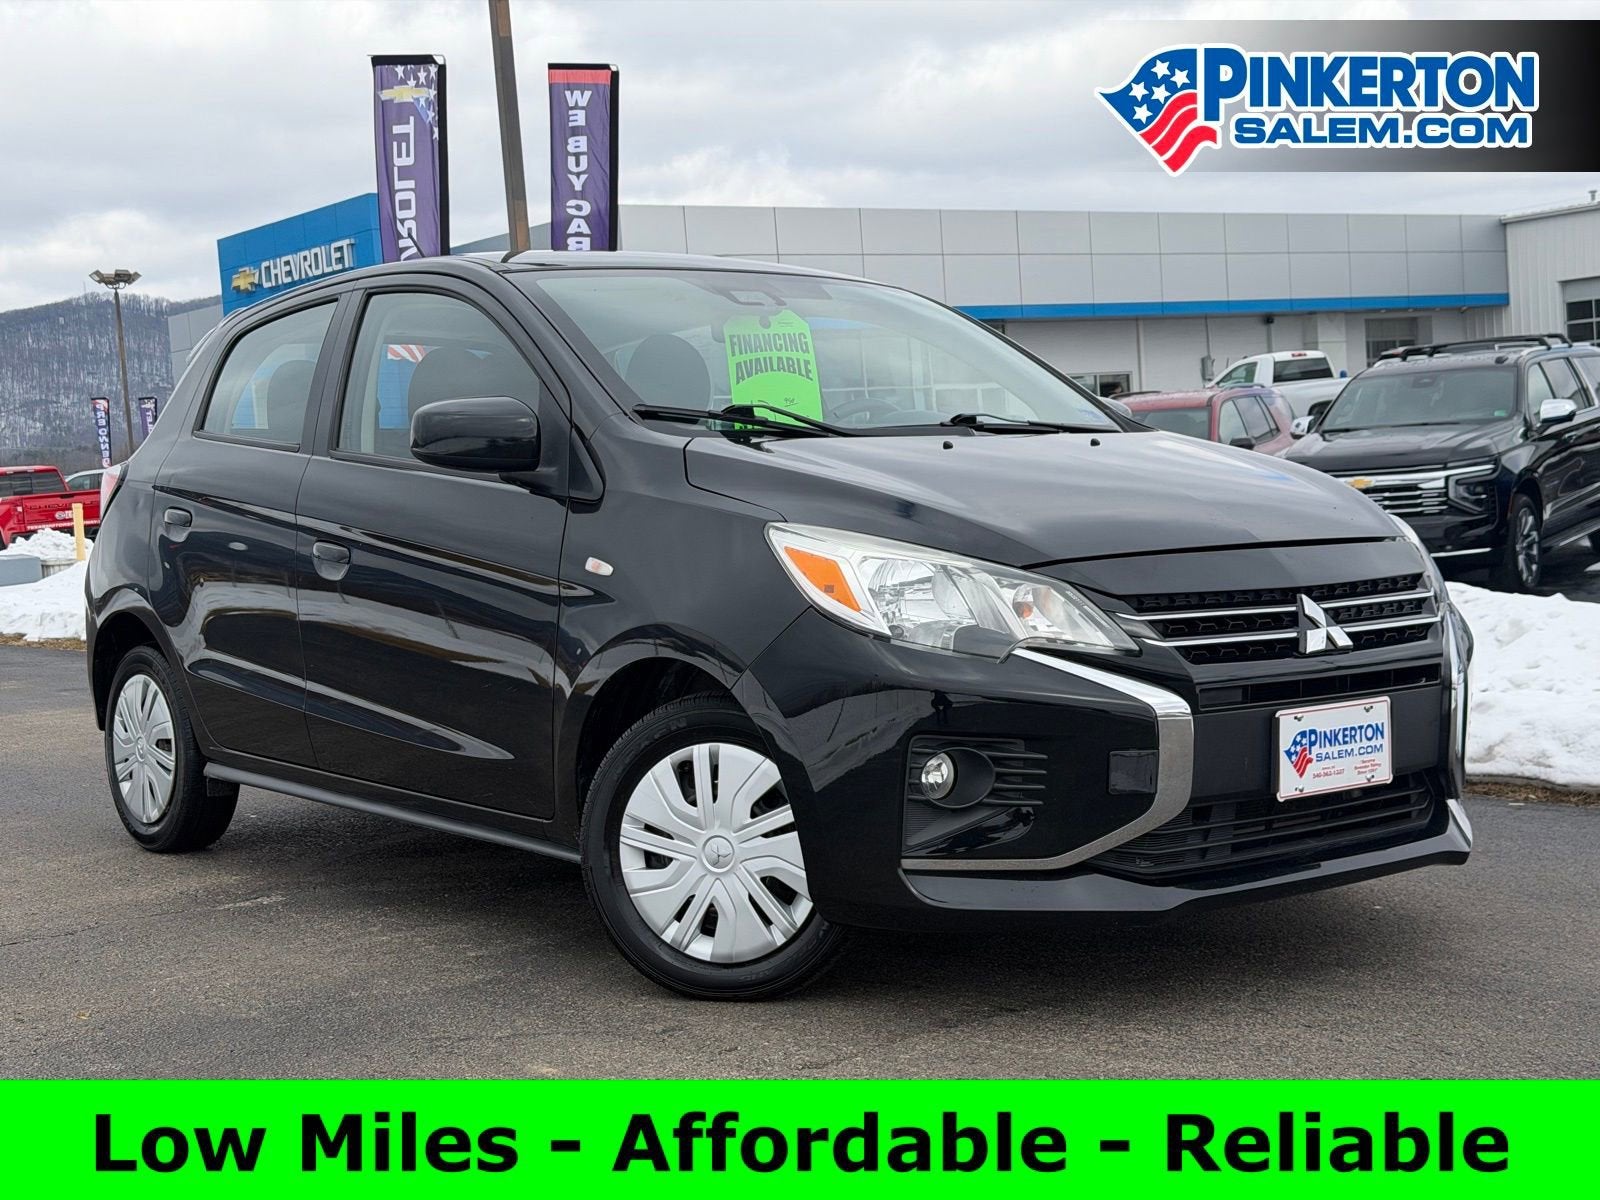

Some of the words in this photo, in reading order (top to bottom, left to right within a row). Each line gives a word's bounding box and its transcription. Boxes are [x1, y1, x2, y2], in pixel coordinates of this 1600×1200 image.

[261, 239, 355, 288] CHEVROLET
[729, 332, 810, 358] FINANCING
[735, 356, 814, 386] AVAILABLE
[1308, 723, 1384, 755] PINKERTON
[1315, 744, 1383, 762] SALEM.COM
